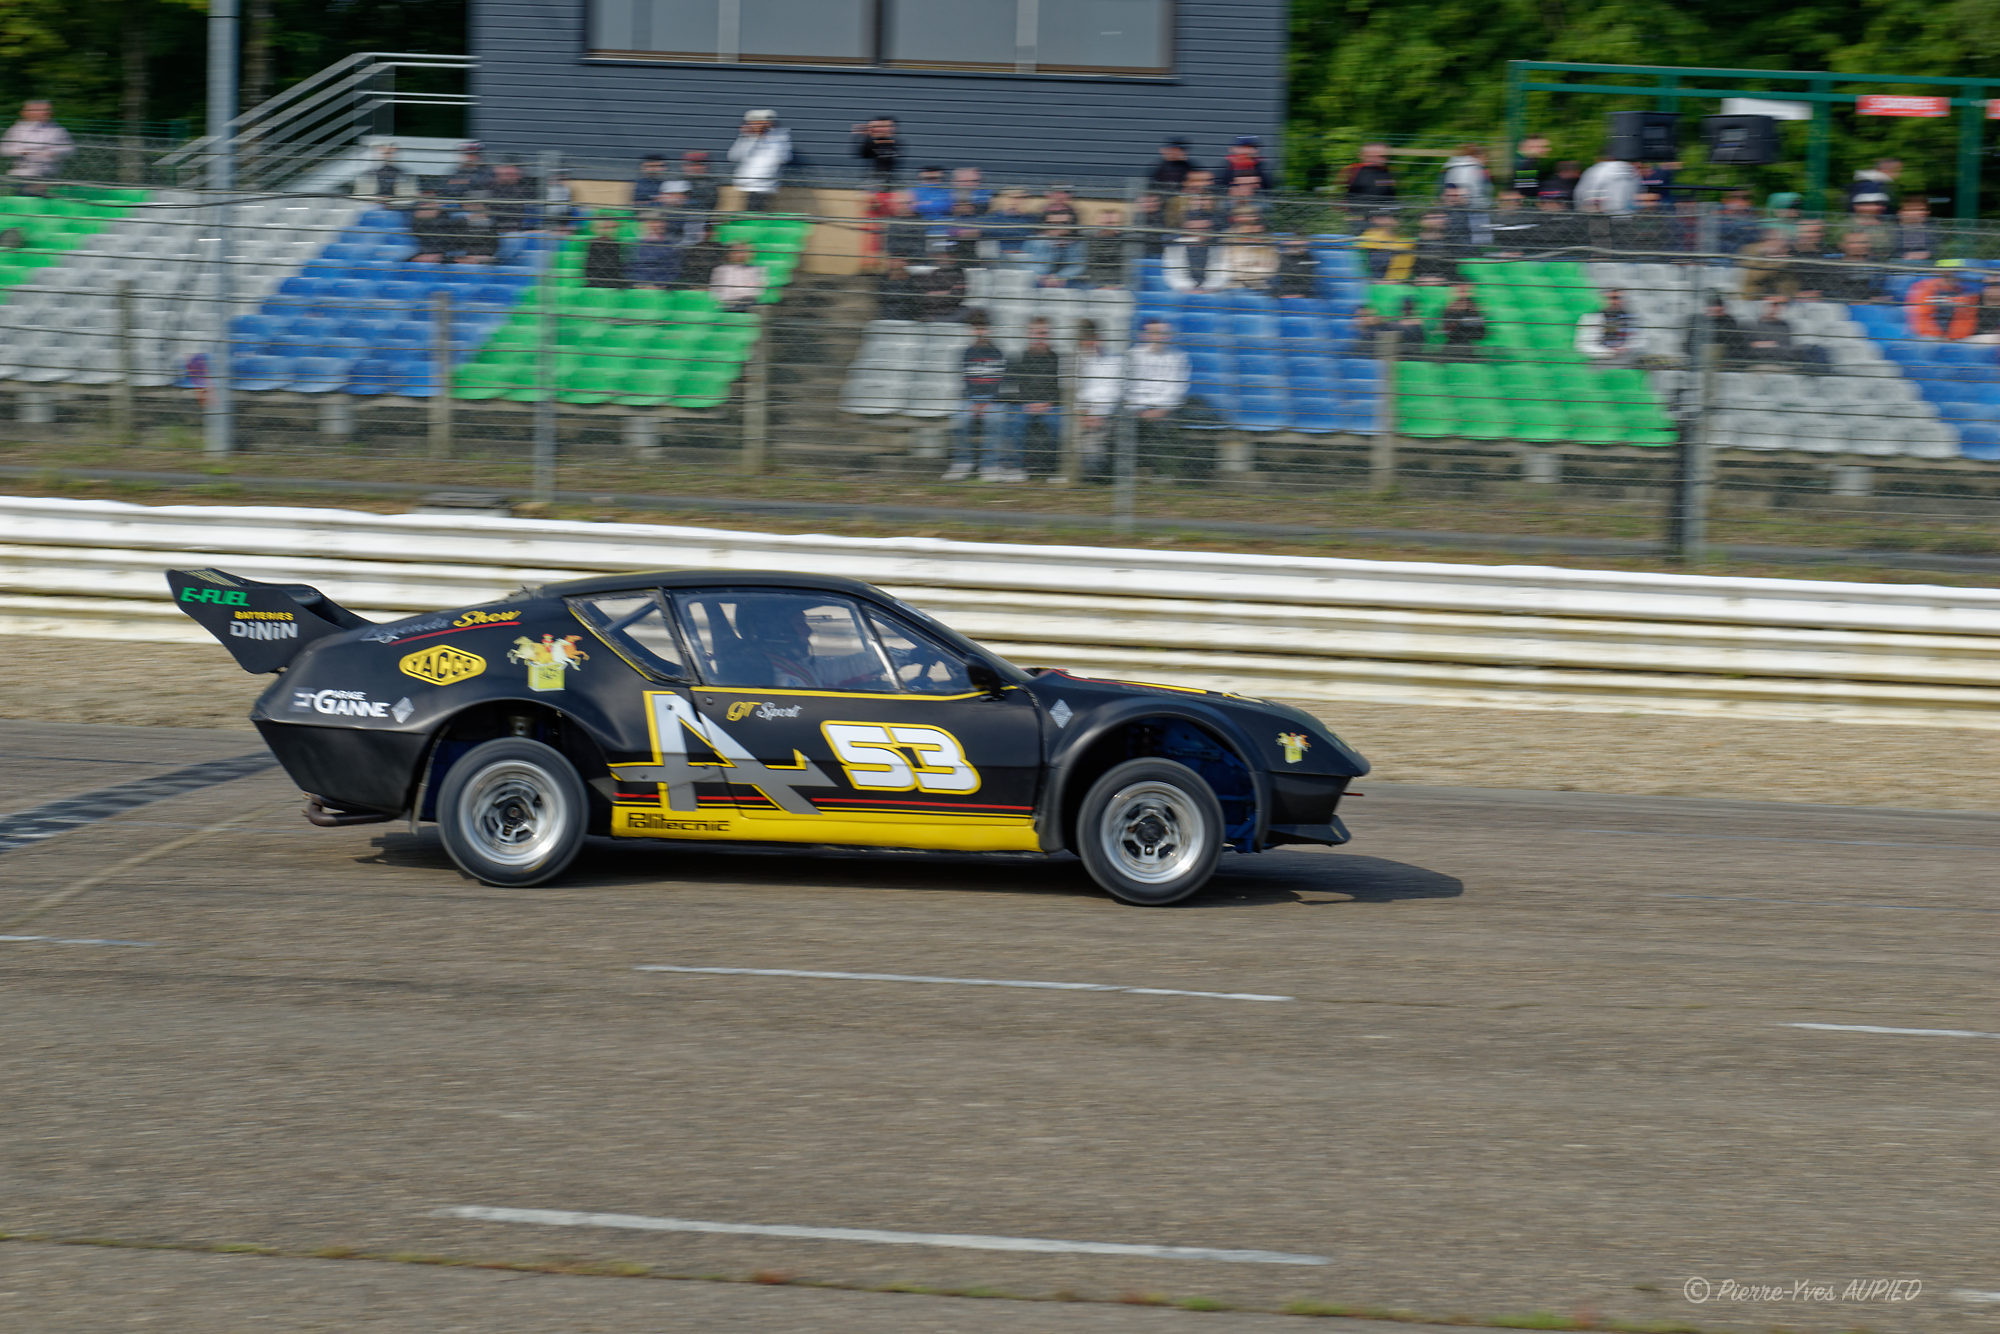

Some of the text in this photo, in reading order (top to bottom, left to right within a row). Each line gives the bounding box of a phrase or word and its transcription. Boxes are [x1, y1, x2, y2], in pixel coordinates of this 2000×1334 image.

[181, 586, 251, 607] E-FUEL
[234, 610, 294, 621] BATTERIES
[453, 610, 522, 628] Show
[406, 650, 476, 680] YACCO
[313, 690, 391, 717] GANNE
[726, 701, 803, 721] GT Sport
[821, 721, 981, 794] 53
